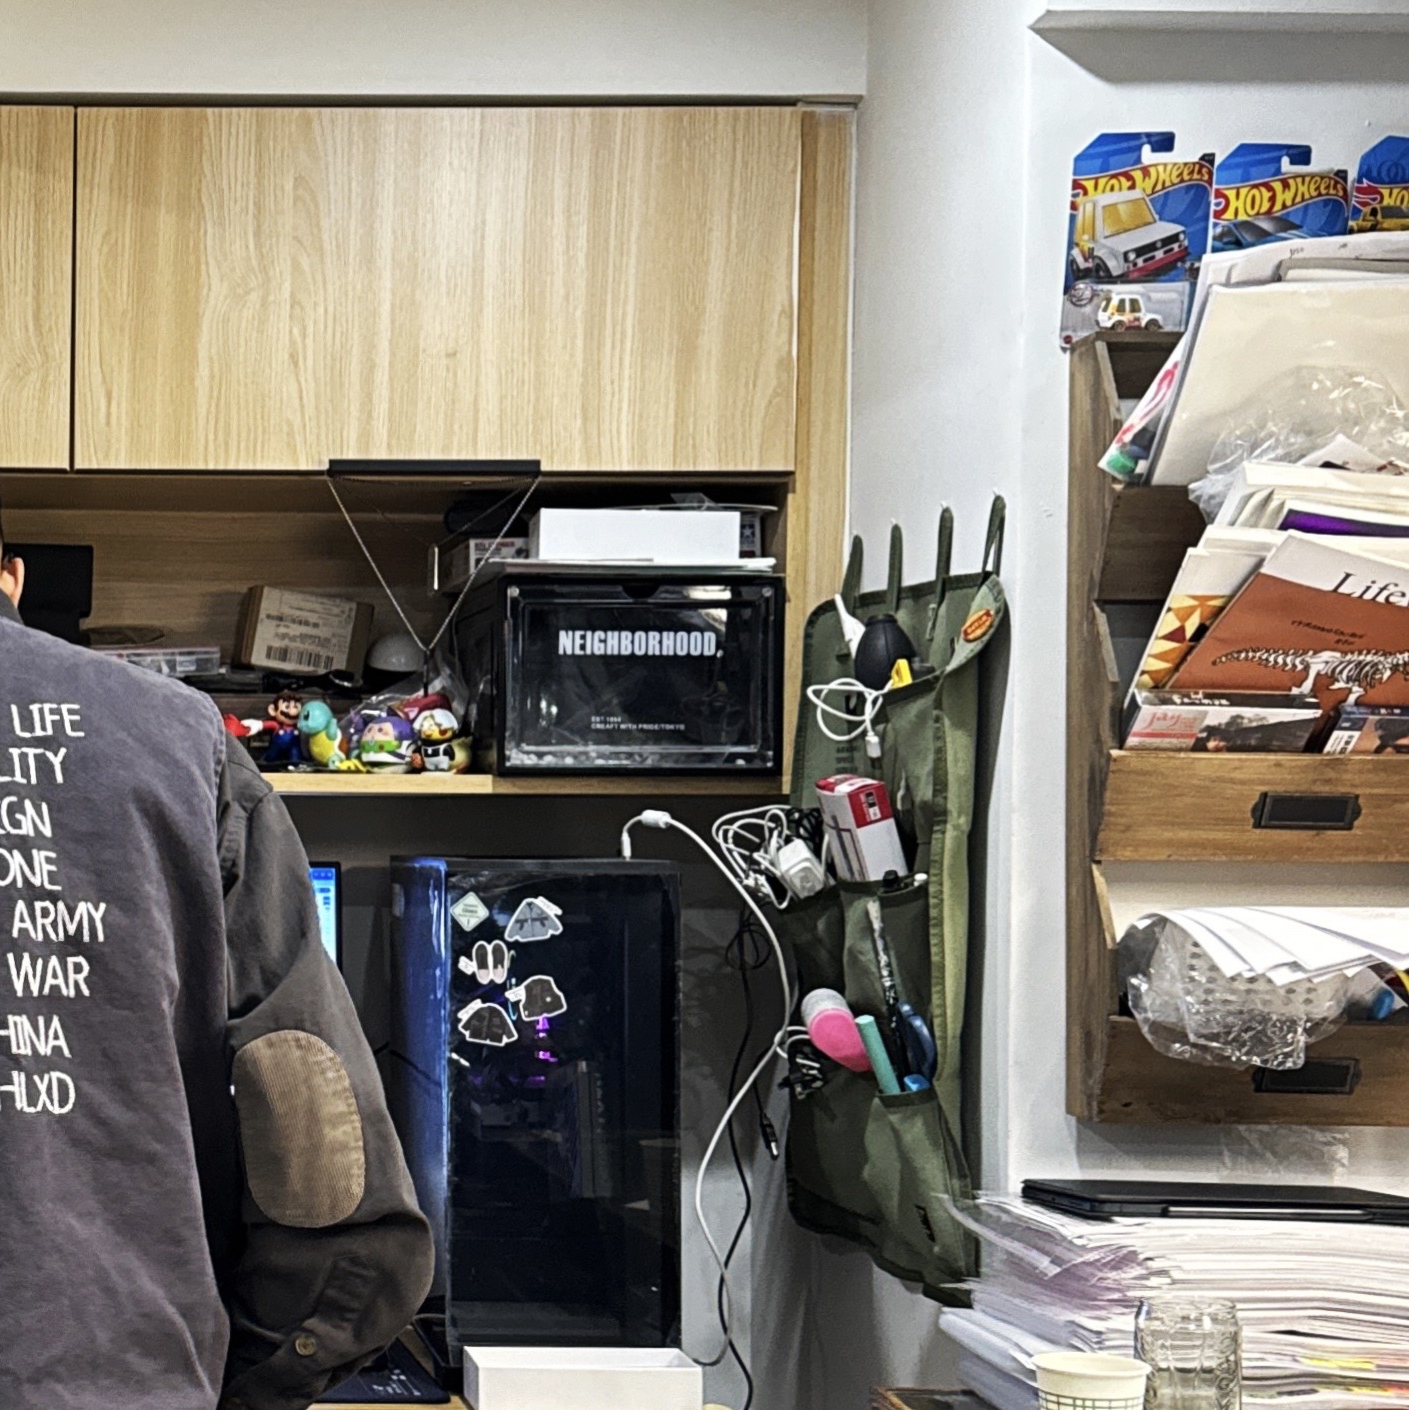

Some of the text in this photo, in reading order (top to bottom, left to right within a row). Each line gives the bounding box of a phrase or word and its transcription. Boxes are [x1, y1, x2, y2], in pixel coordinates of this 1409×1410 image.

[1329, 570, 1407, 605] Life
[558, 630, 717, 656] NEIGHBORHOOD
[11, 703, 85, 738] LIFE
[11, 900, 107, 943] ARMY
[6, 952, 90, 998] WAR
